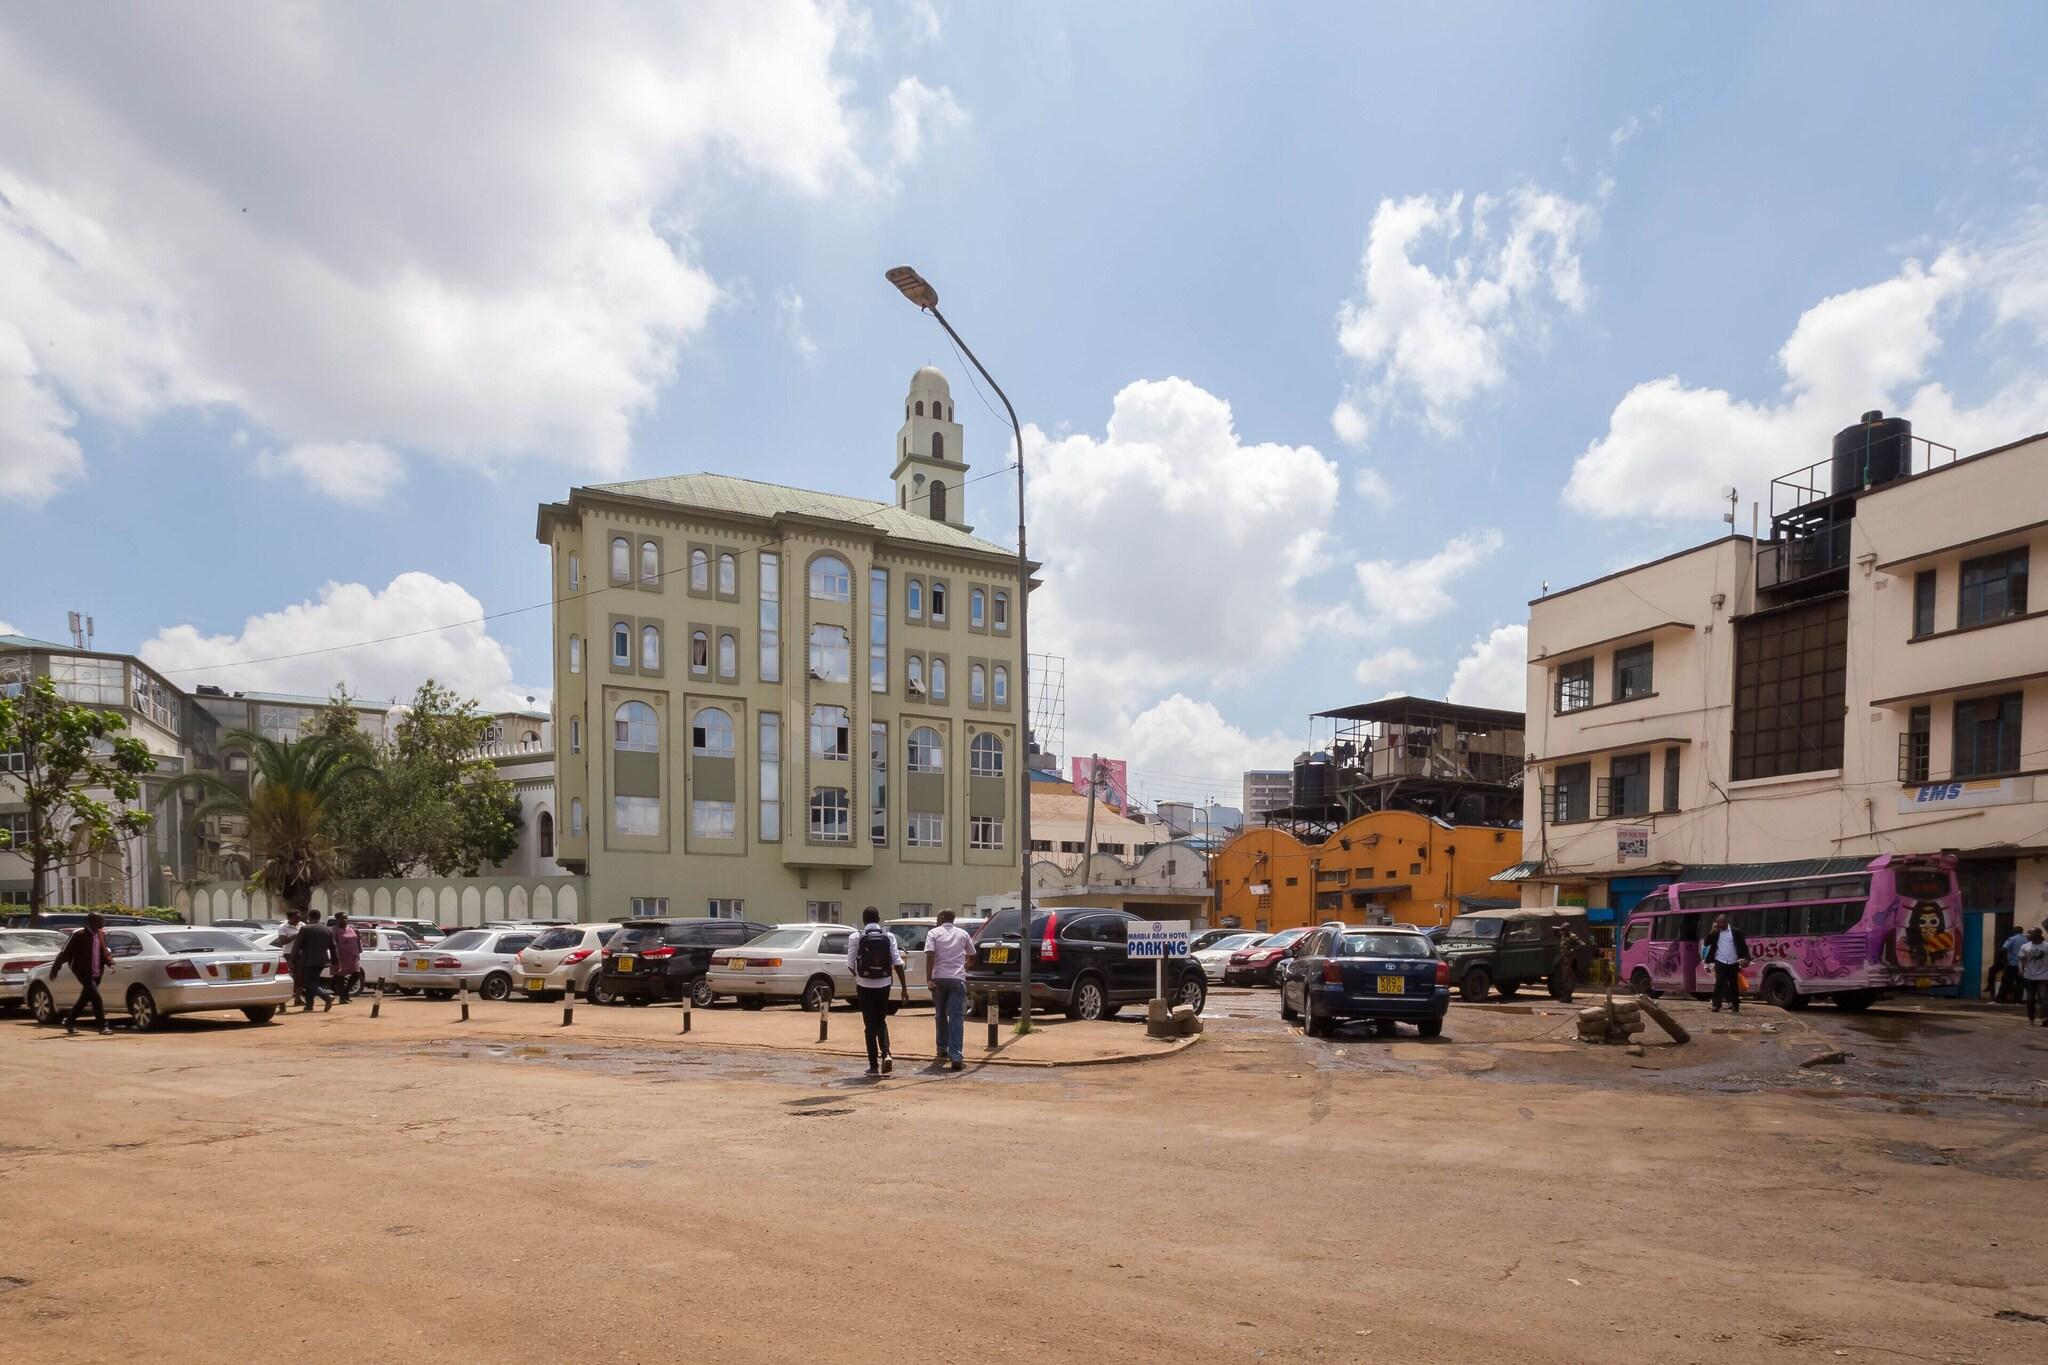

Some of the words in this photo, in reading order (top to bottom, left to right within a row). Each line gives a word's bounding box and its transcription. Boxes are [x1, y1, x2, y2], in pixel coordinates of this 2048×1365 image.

[1917, 783, 1962, 802] EMS
[1129, 932, 1150, 940] MARBLE
[1128, 941, 1188, 956] PARKING
[1749, 942, 1791, 959] ose
